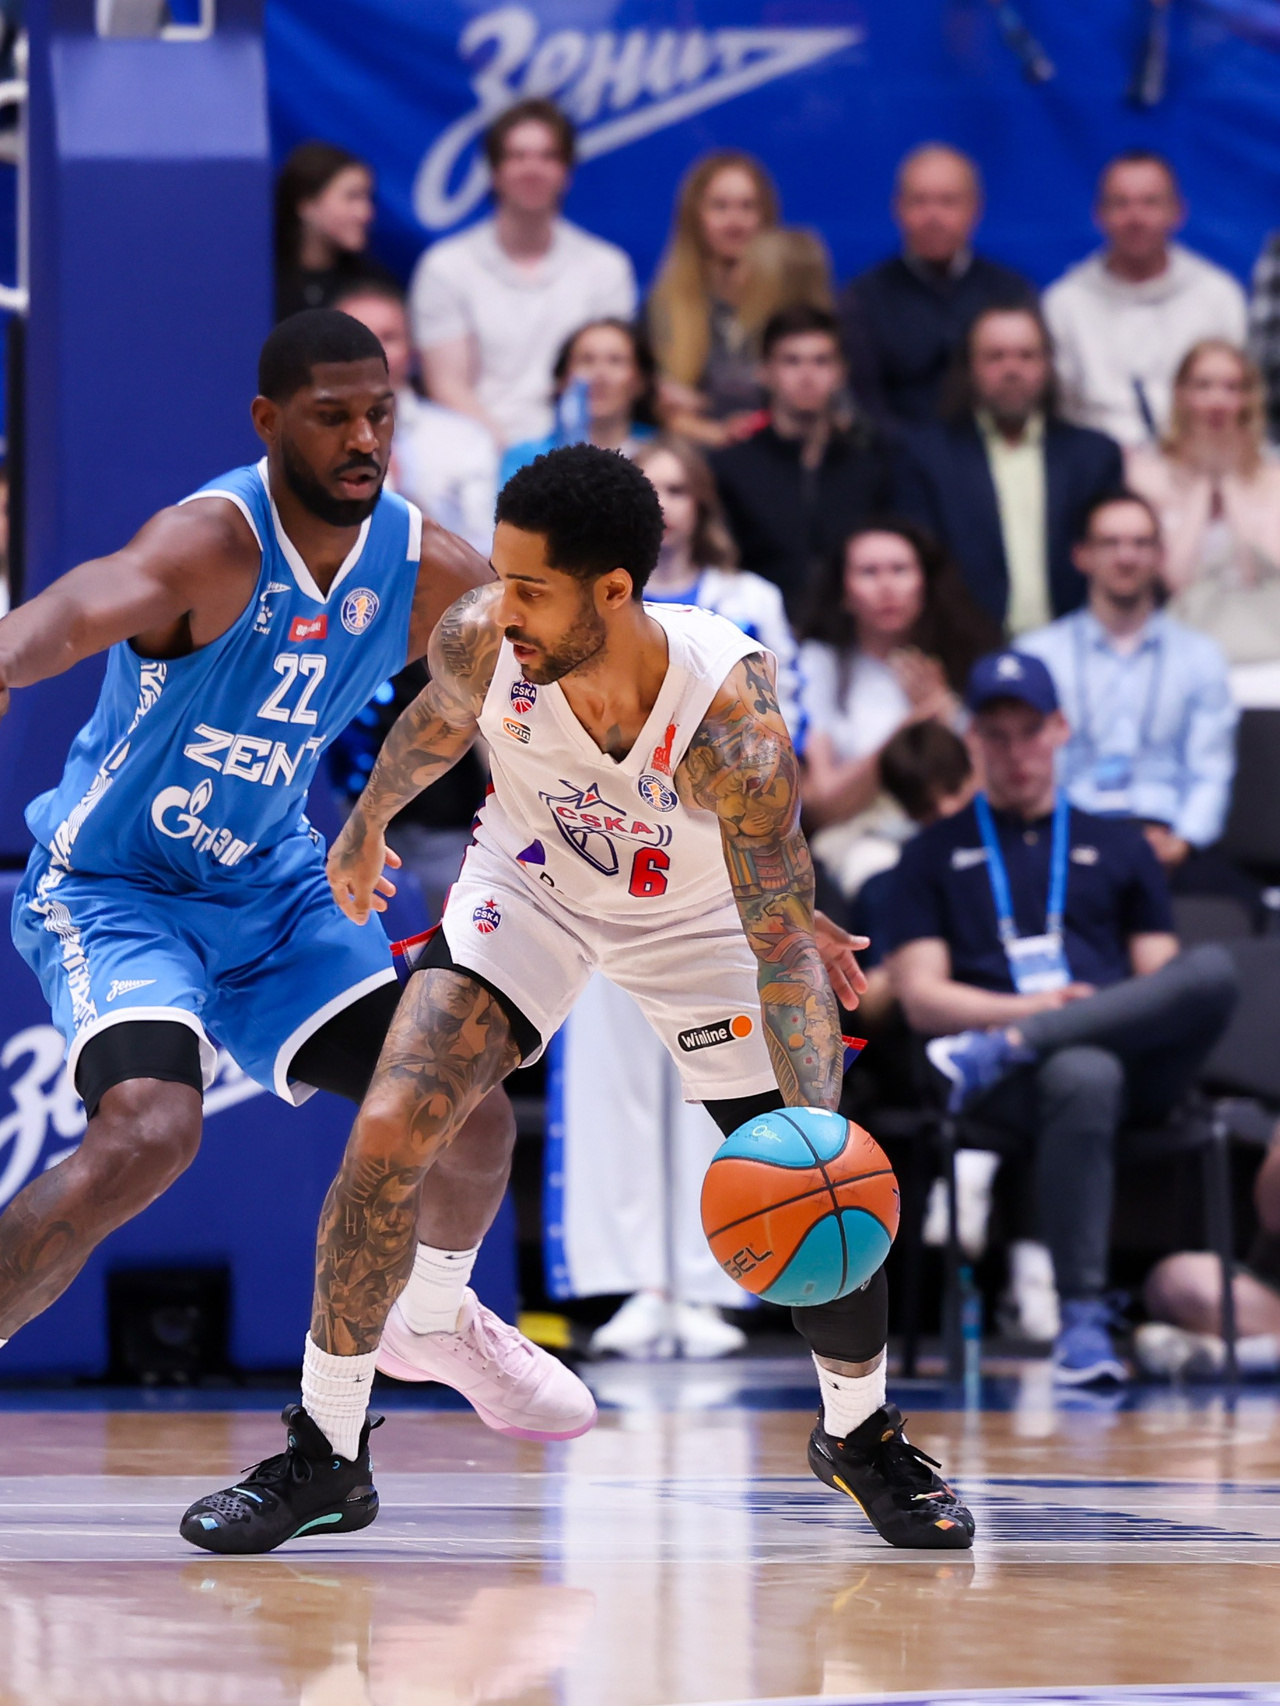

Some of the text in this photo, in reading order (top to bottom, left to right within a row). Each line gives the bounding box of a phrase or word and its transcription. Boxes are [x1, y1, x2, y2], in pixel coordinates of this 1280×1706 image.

[257, 653, 327, 725] 22
[512, 685, 536, 699] CSKA
[556, 806, 655, 835] CSKA
[628, 847, 670, 897] 6
[474, 909, 499, 924] CSKA
[723, 1246, 773, 1280] GEL
